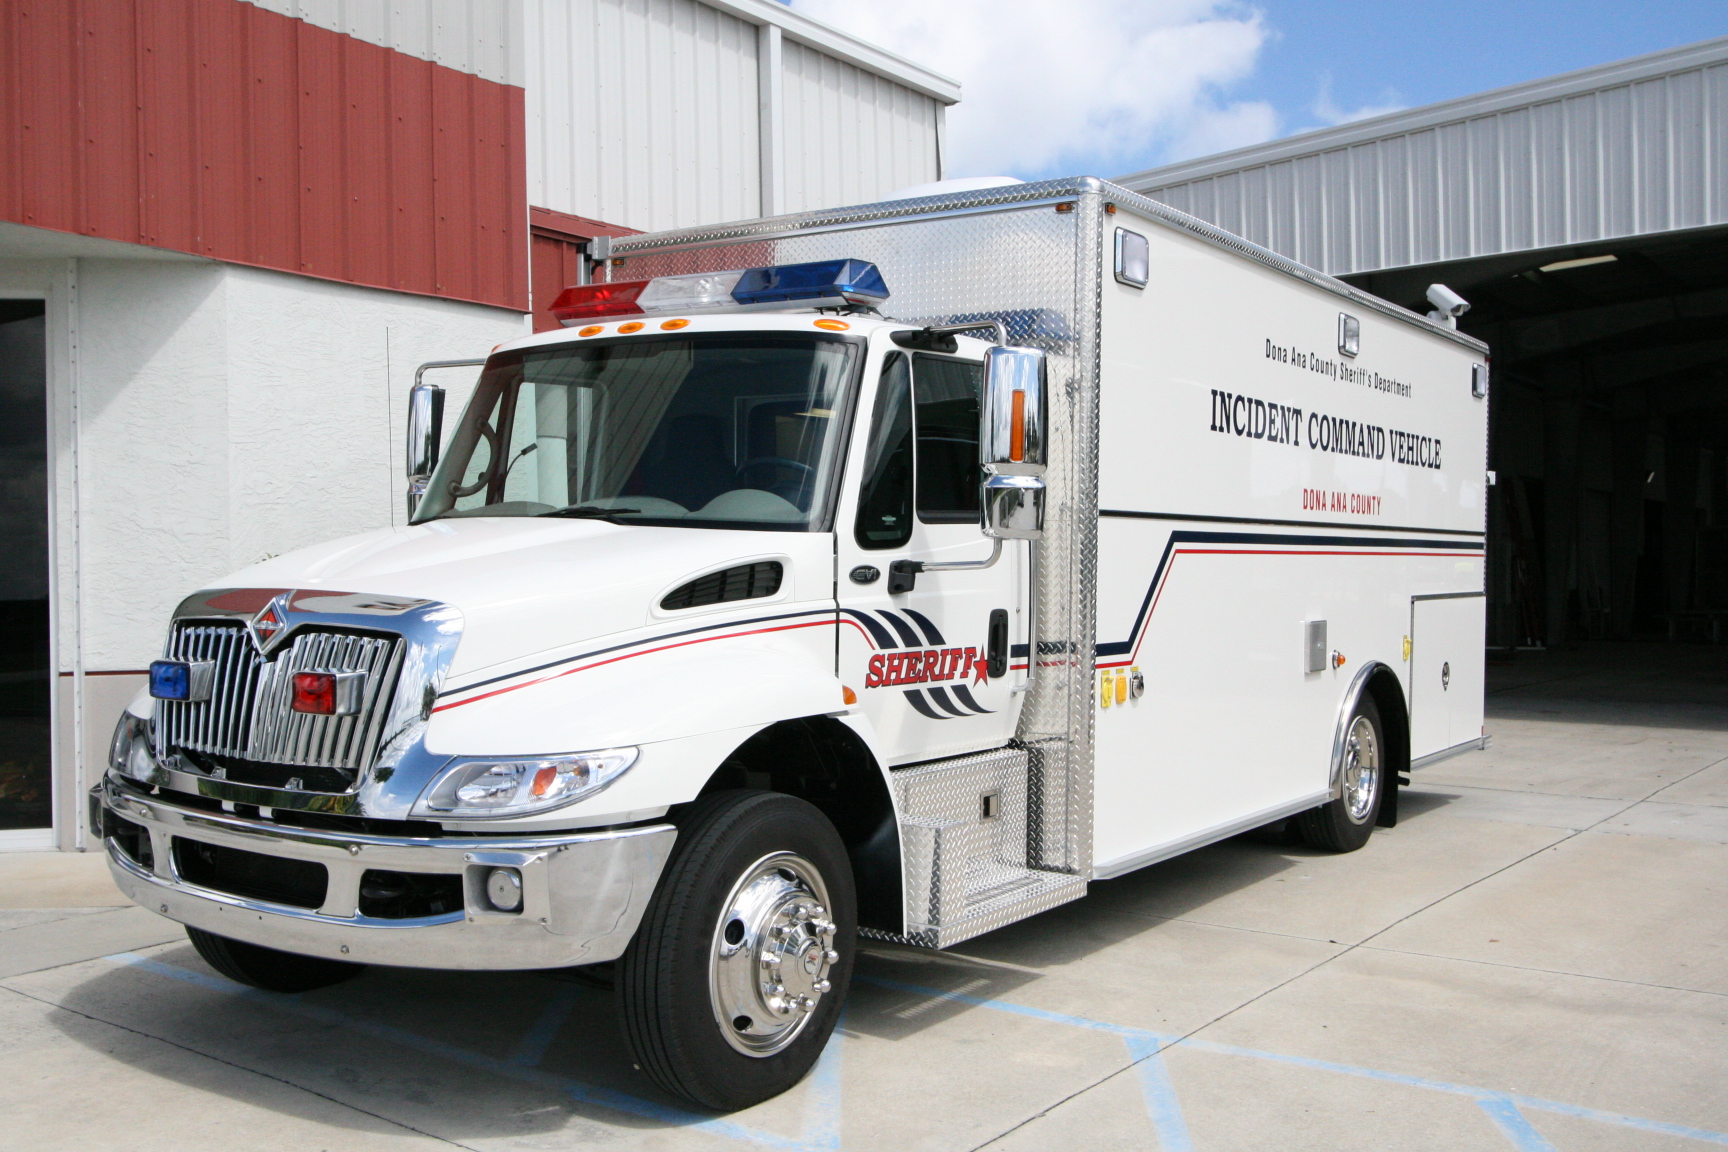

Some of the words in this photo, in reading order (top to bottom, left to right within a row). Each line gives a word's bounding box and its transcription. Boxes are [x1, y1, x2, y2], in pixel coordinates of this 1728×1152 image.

[1265, 338, 1288, 363] Dona
[1290, 346, 1307, 369] Ana
[1309, 351, 1338, 382] County
[1339, 362, 1372, 388] Sheriff's
[1374, 371, 1412, 399] Department
[1210, 388, 1302, 447] INCIDENT
[1307, 412, 1385, 461] COMMAND
[1389, 429, 1442, 470] VEHICLE
[1303, 488, 1327, 512] DONA
[1330, 491, 1347, 514] ANA
[1350, 493, 1382, 516] COUNTY
[865, 646, 978, 689] SHERIFF
